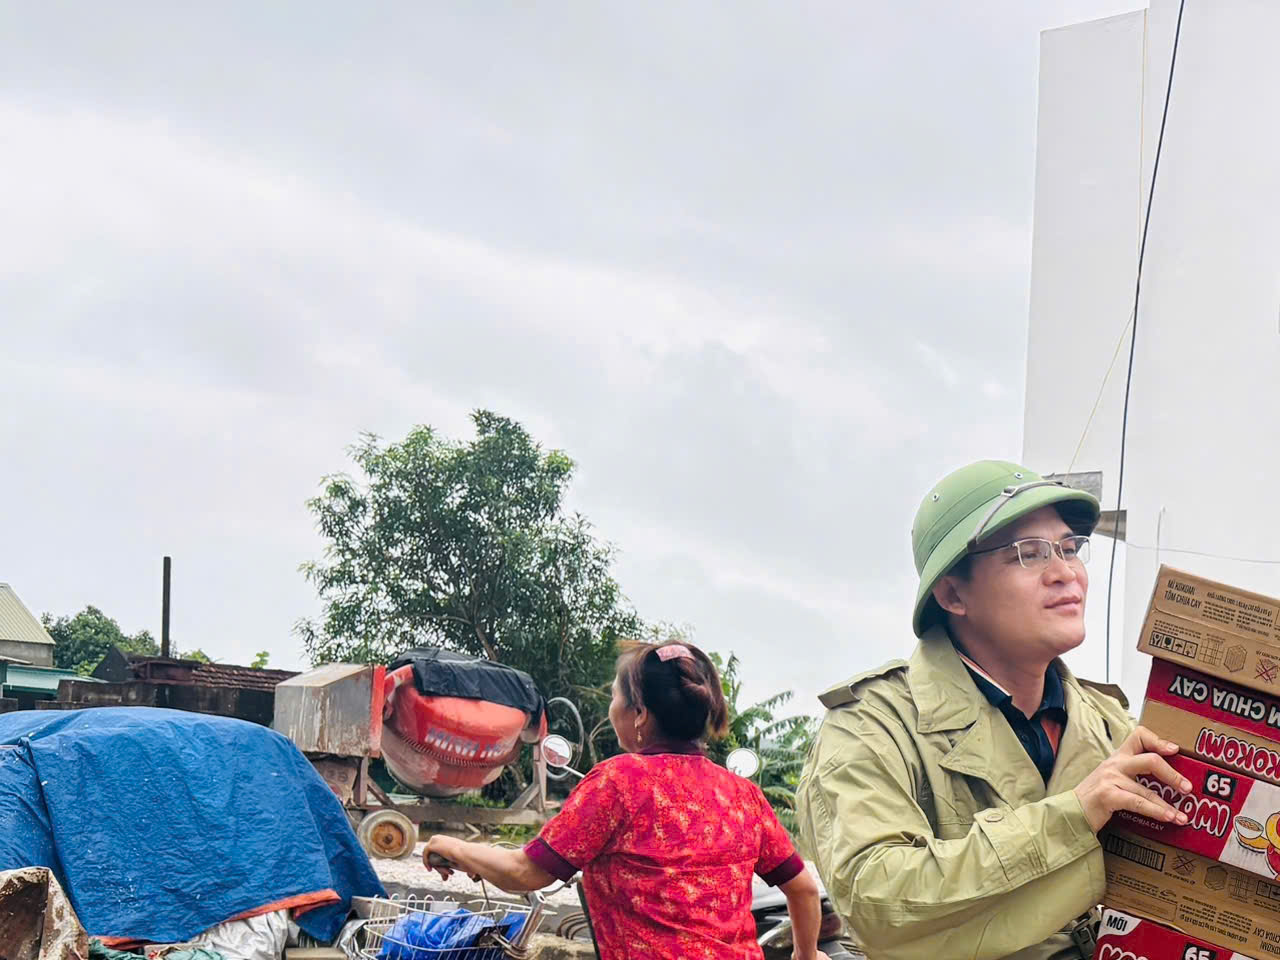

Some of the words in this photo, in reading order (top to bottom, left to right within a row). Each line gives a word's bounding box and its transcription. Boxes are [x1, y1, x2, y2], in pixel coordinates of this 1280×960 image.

[1164, 590, 1175, 601] TÔM
[1176, 594, 1190, 607] CHUA
[1191, 597, 1202, 609] CAY
[1169, 676, 1207, 701] CAY
[1213, 688, 1265, 720] CHUA
[1206, 774, 1231, 796] 65
[1106, 915, 1128, 932] MỚI
